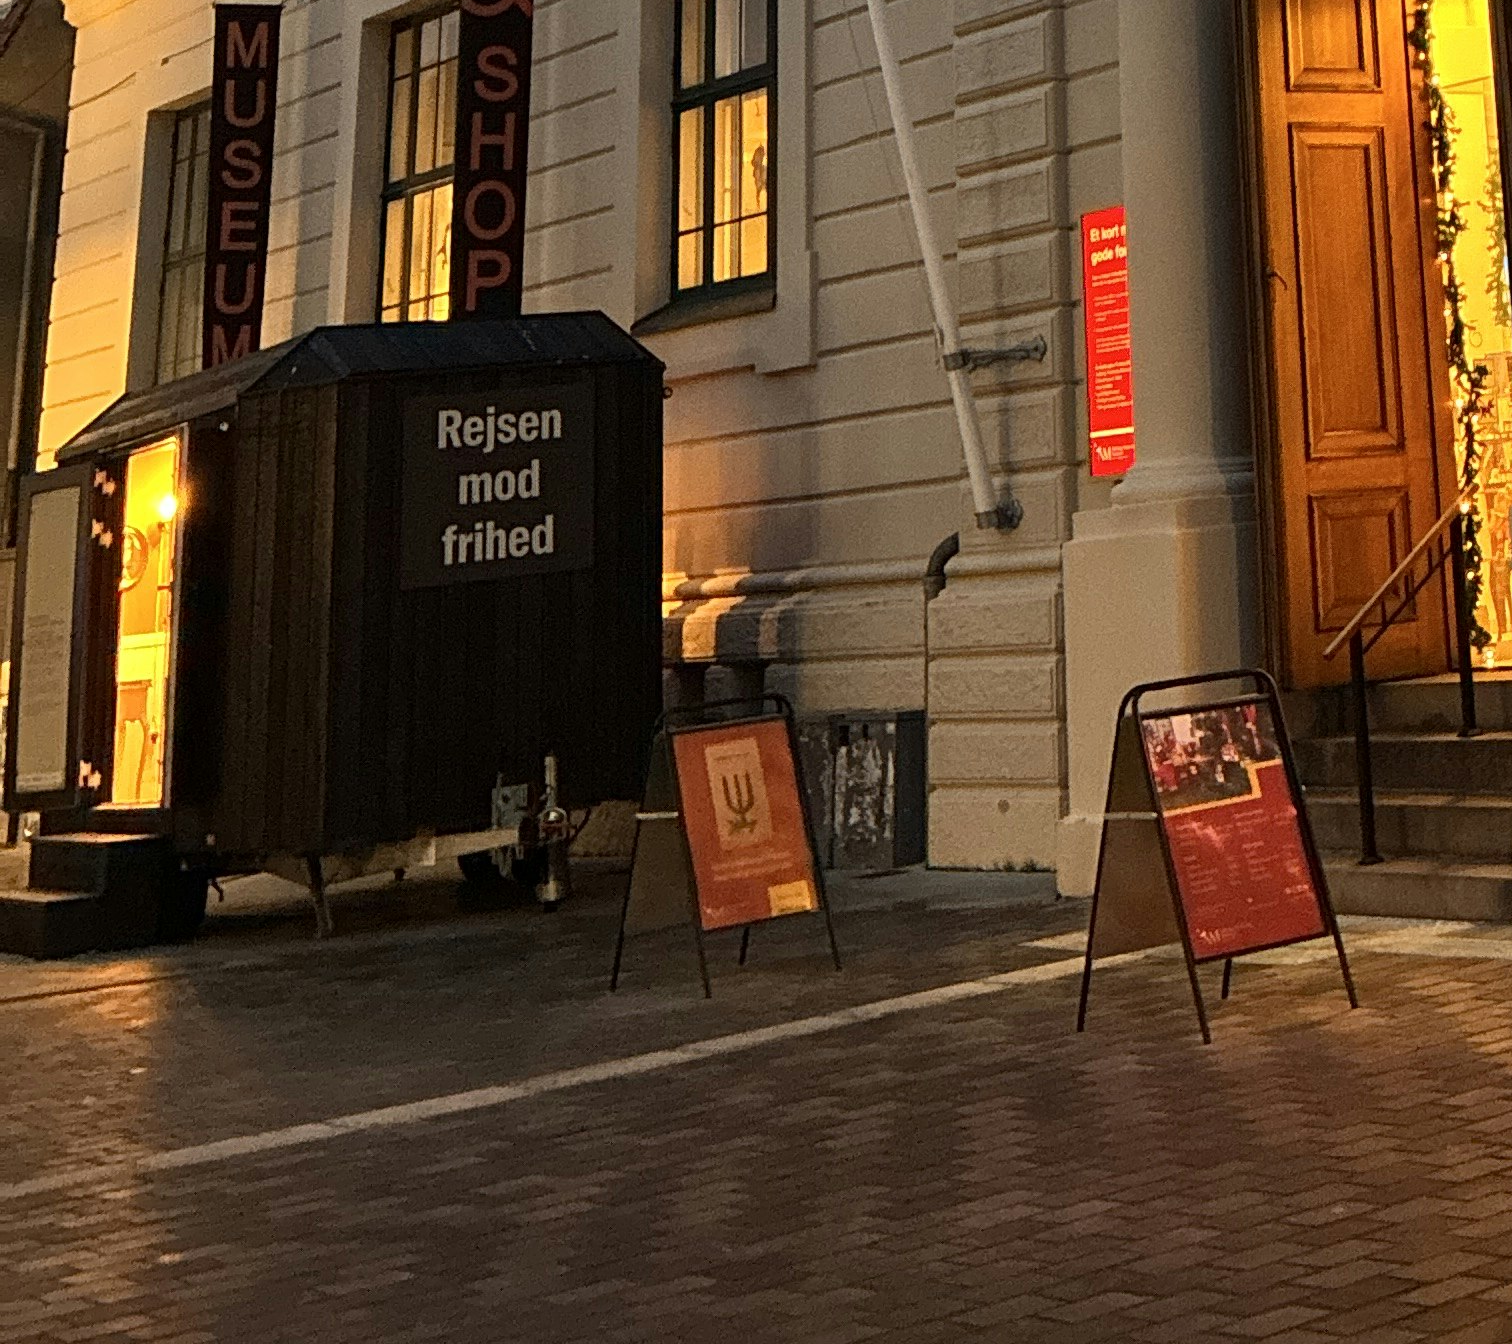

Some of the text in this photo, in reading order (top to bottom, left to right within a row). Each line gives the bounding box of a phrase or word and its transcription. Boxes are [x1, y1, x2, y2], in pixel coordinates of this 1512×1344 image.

[211, 21, 269, 369] MUSEUM
[463, 45, 519, 312] SHOP
[437, 406, 562, 454] Rejsen
[458, 459, 540, 505] mod
[441, 514, 554, 566] frihed
